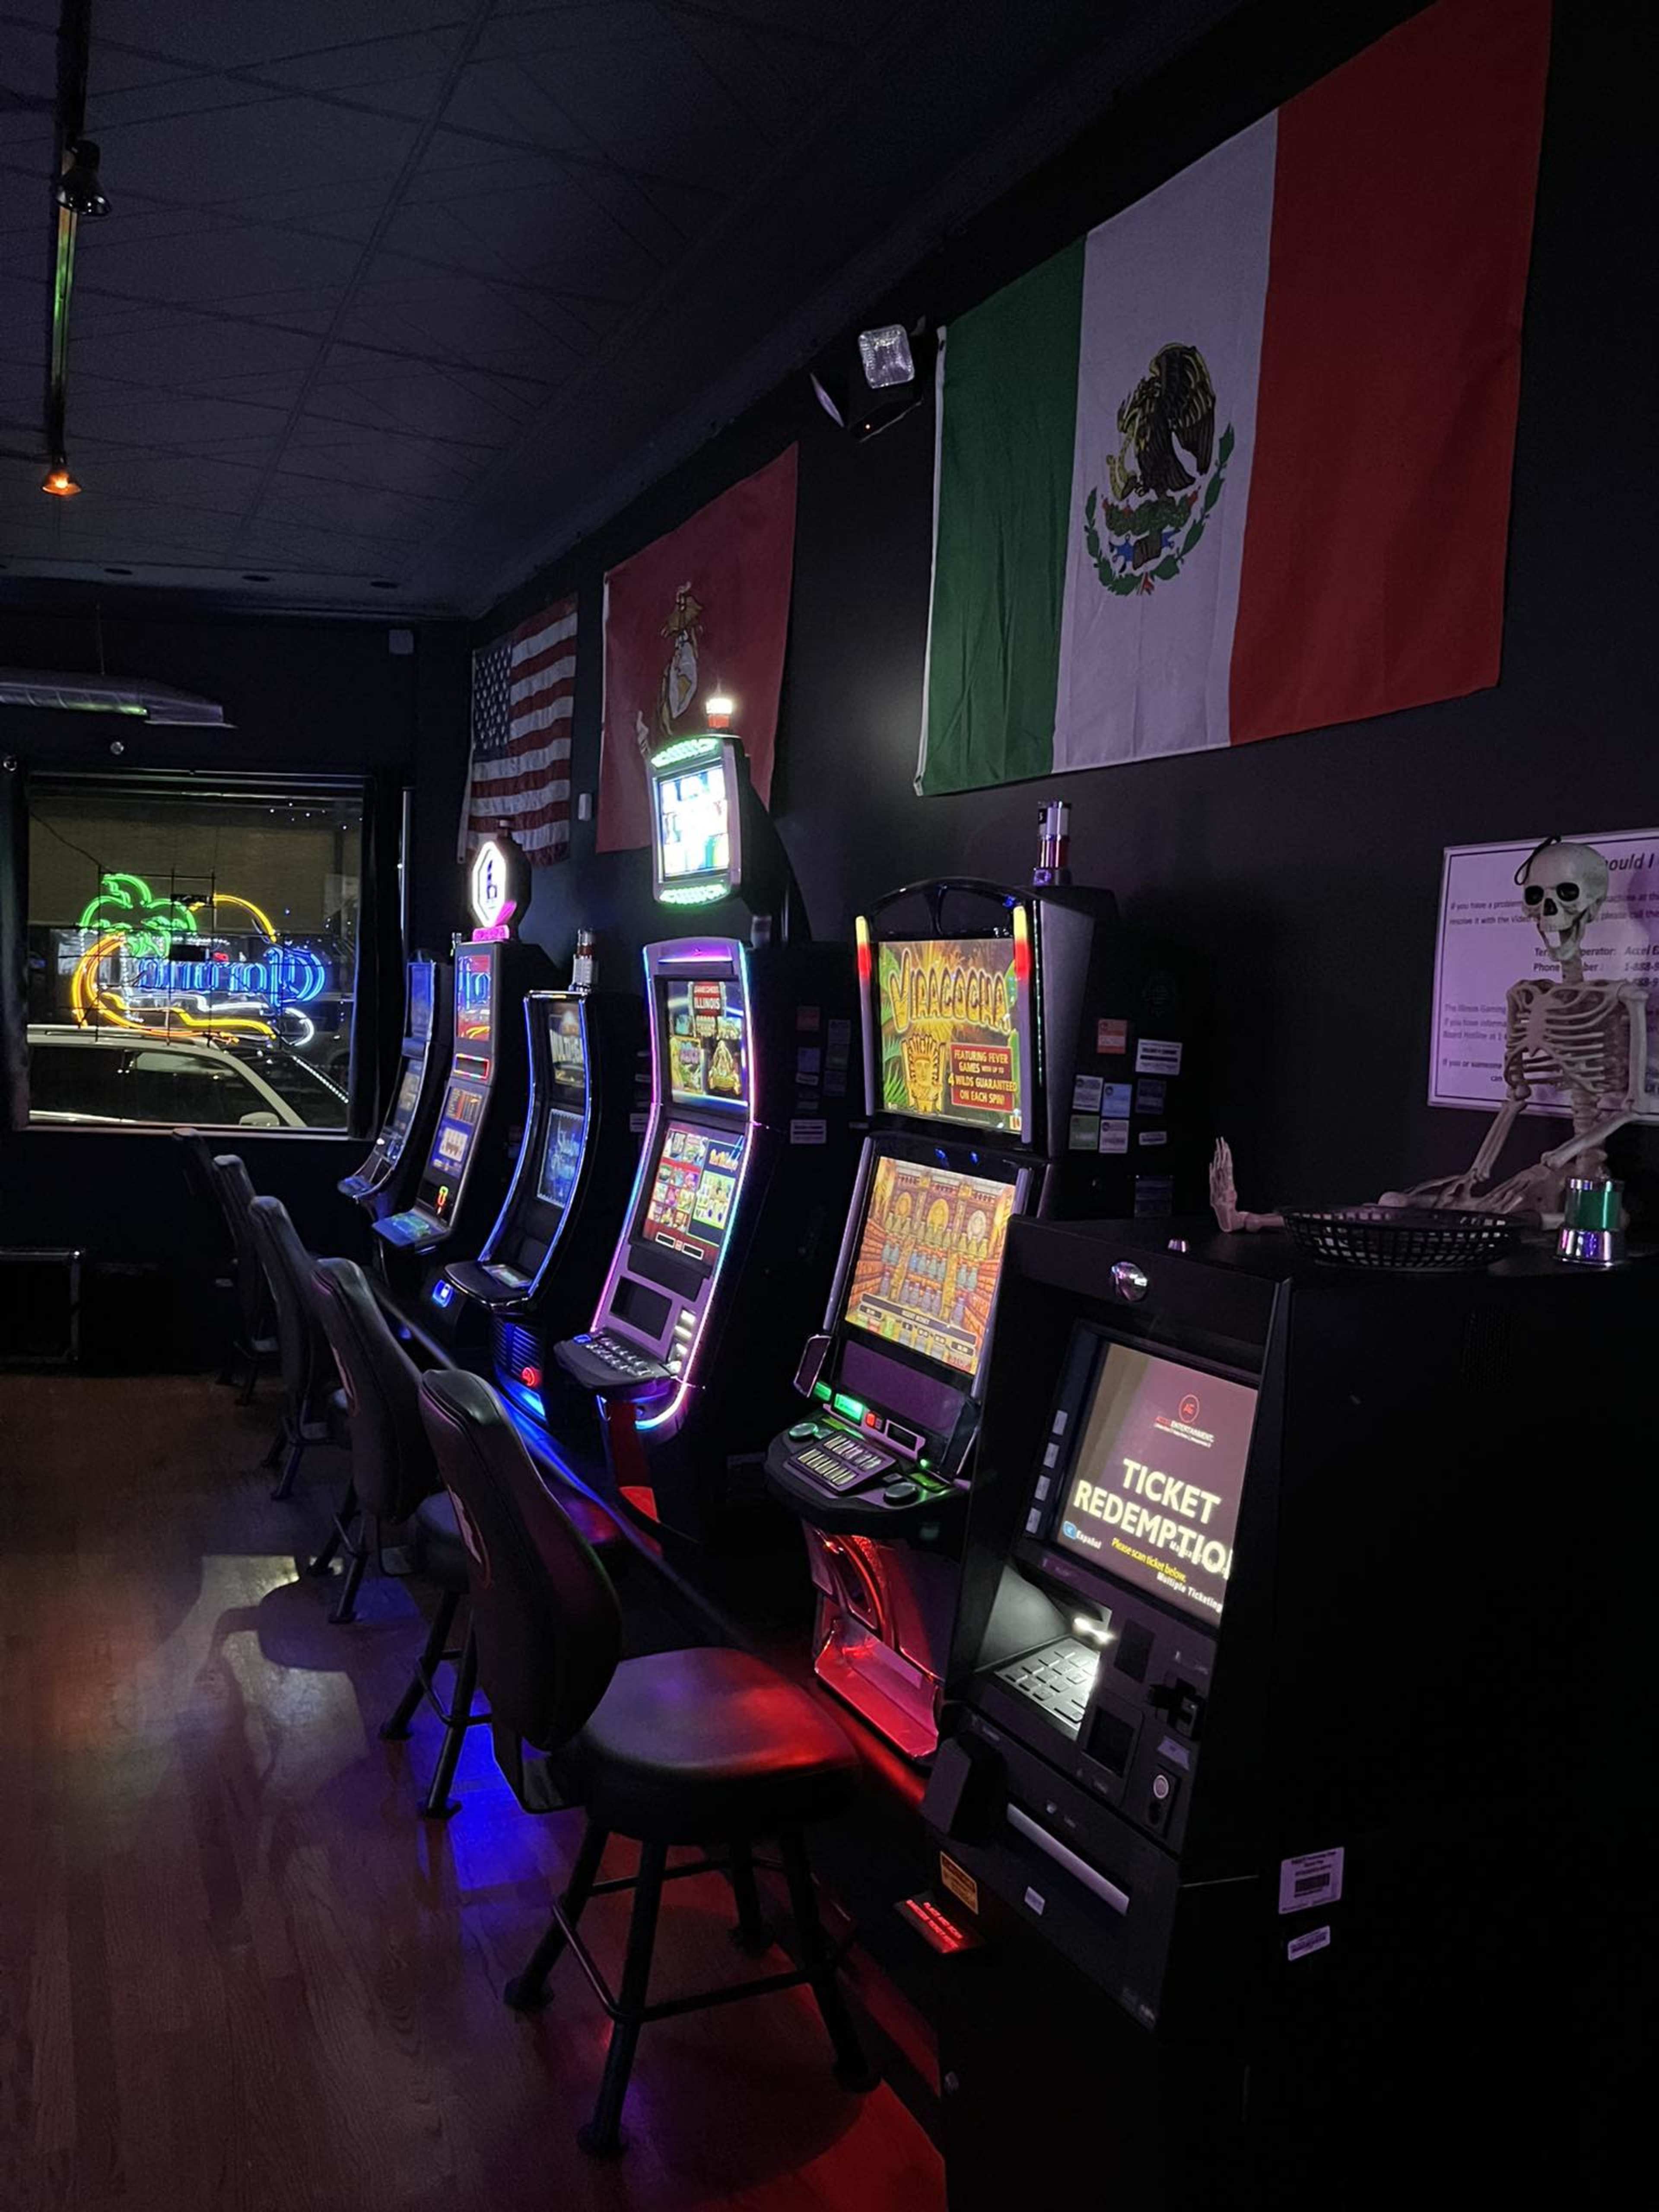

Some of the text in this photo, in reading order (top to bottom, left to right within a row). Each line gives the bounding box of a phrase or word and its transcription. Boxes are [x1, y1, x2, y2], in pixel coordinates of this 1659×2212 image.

[1605, 852, 1655, 871] ould I
[1534, 963, 1560, 972] Phone
[694, 998, 720, 1010] ILLINOIS
[954, 1049, 1008, 1064] FEATURING FEVER
[959, 1062, 980, 1073] GAMES
[948, 1072, 1017, 1092] 4 WILDS GUARANTEED
[960, 1090, 969, 1100] ON
[971, 1091, 987, 1102] EACH
[1123, 1458, 1221, 1524] TICKET
[1112, 1537, 1131, 1555] Please
[1130, 1547, 1147, 1564] scan
[1146, 1554, 1166, 1573] ticket
[1157, 1571, 1224, 1614] Multiple Ticketing
